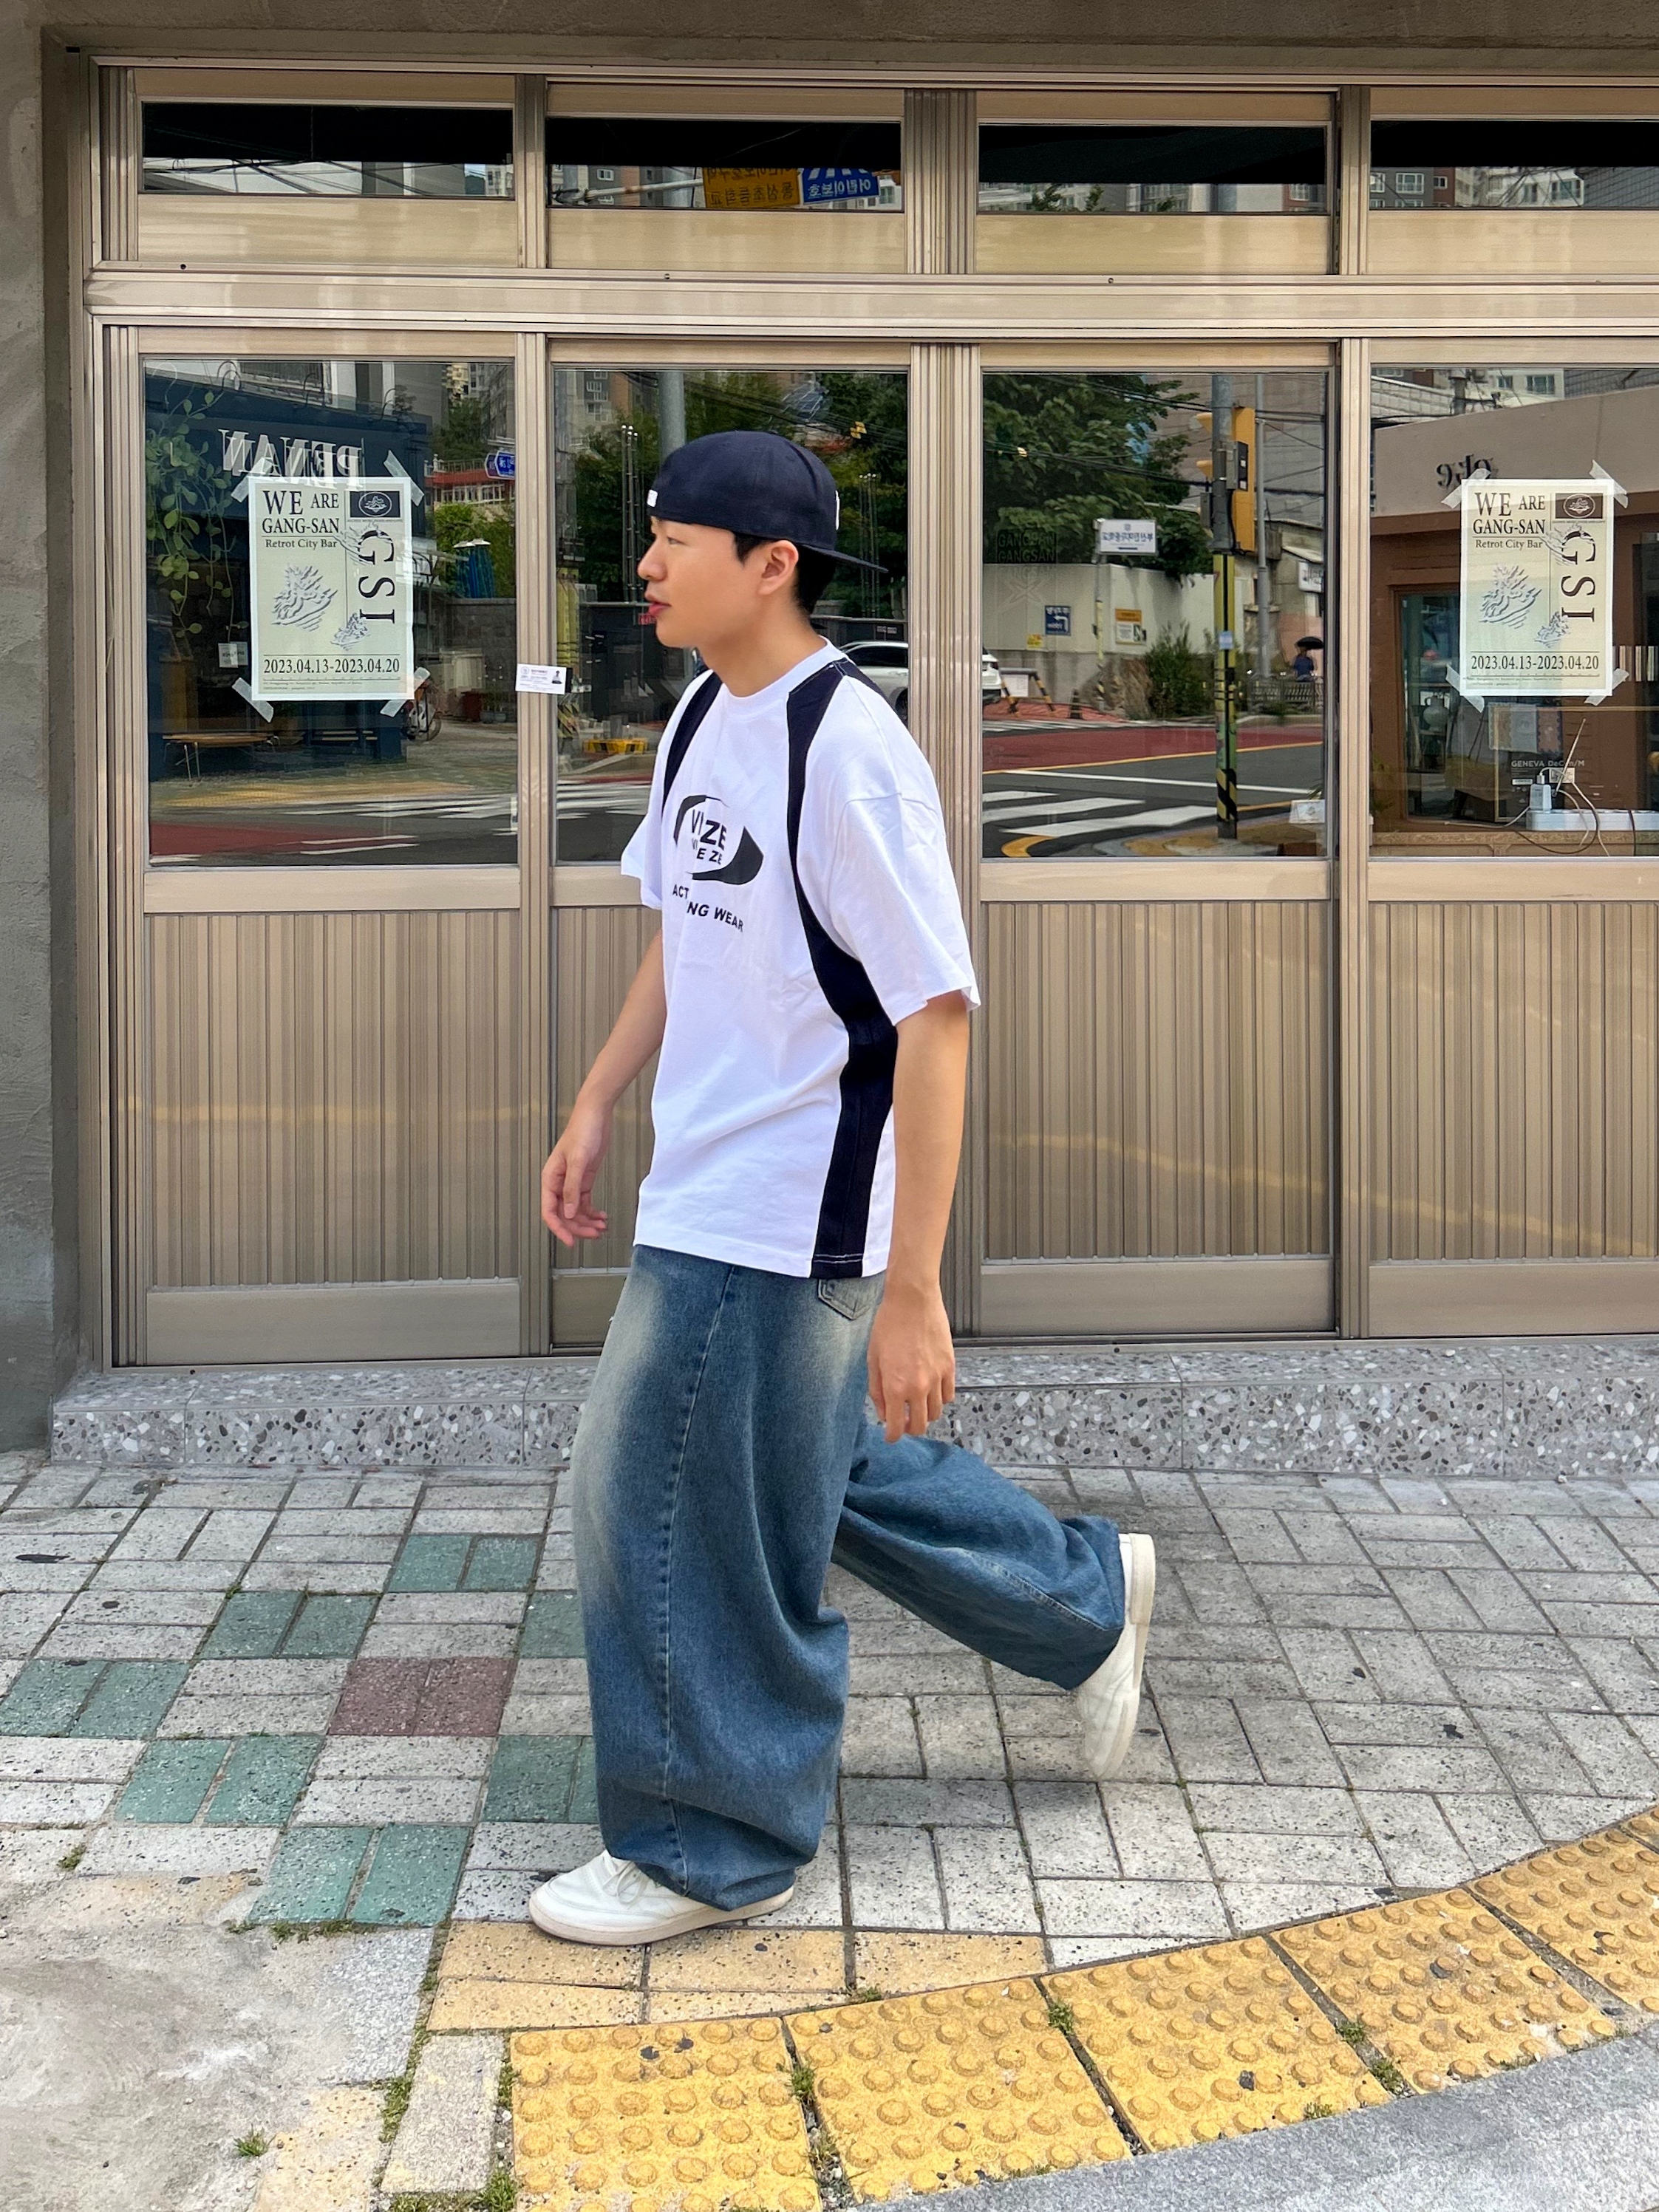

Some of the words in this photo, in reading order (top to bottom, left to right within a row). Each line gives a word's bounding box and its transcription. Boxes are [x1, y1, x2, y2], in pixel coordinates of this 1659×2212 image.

[262, 491, 303, 515] WE
[310, 493, 339, 508] ARE
[1474, 492, 1512, 516] WE
[1519, 495, 1545, 510] ARE
[262, 518, 340, 533] GANG-SAN
[1473, 519, 1545, 534] GANG-SAN
[265, 539, 295, 548] Retrot
[298, 539, 318, 550] City
[321, 539, 337, 548] Bar
[998, 532, 1055, 547] GANGSAN
[1475, 539, 1503, 549] Retrot
[1507, 539, 1525, 550] City
[1527, 539, 1543, 549] Bar
[998, 548, 1055, 563] GANGSAN
[358, 530, 395, 624] GSI
[1561, 530, 1596, 622] GSI
[264, 658, 400, 673] 2023.04.13-2023.04.20
[1471, 655, 1599, 669] 2023.04.13-2023.04.20
[672, 884, 709, 917] ACTNG
[714, 907, 743, 932] WEAR
